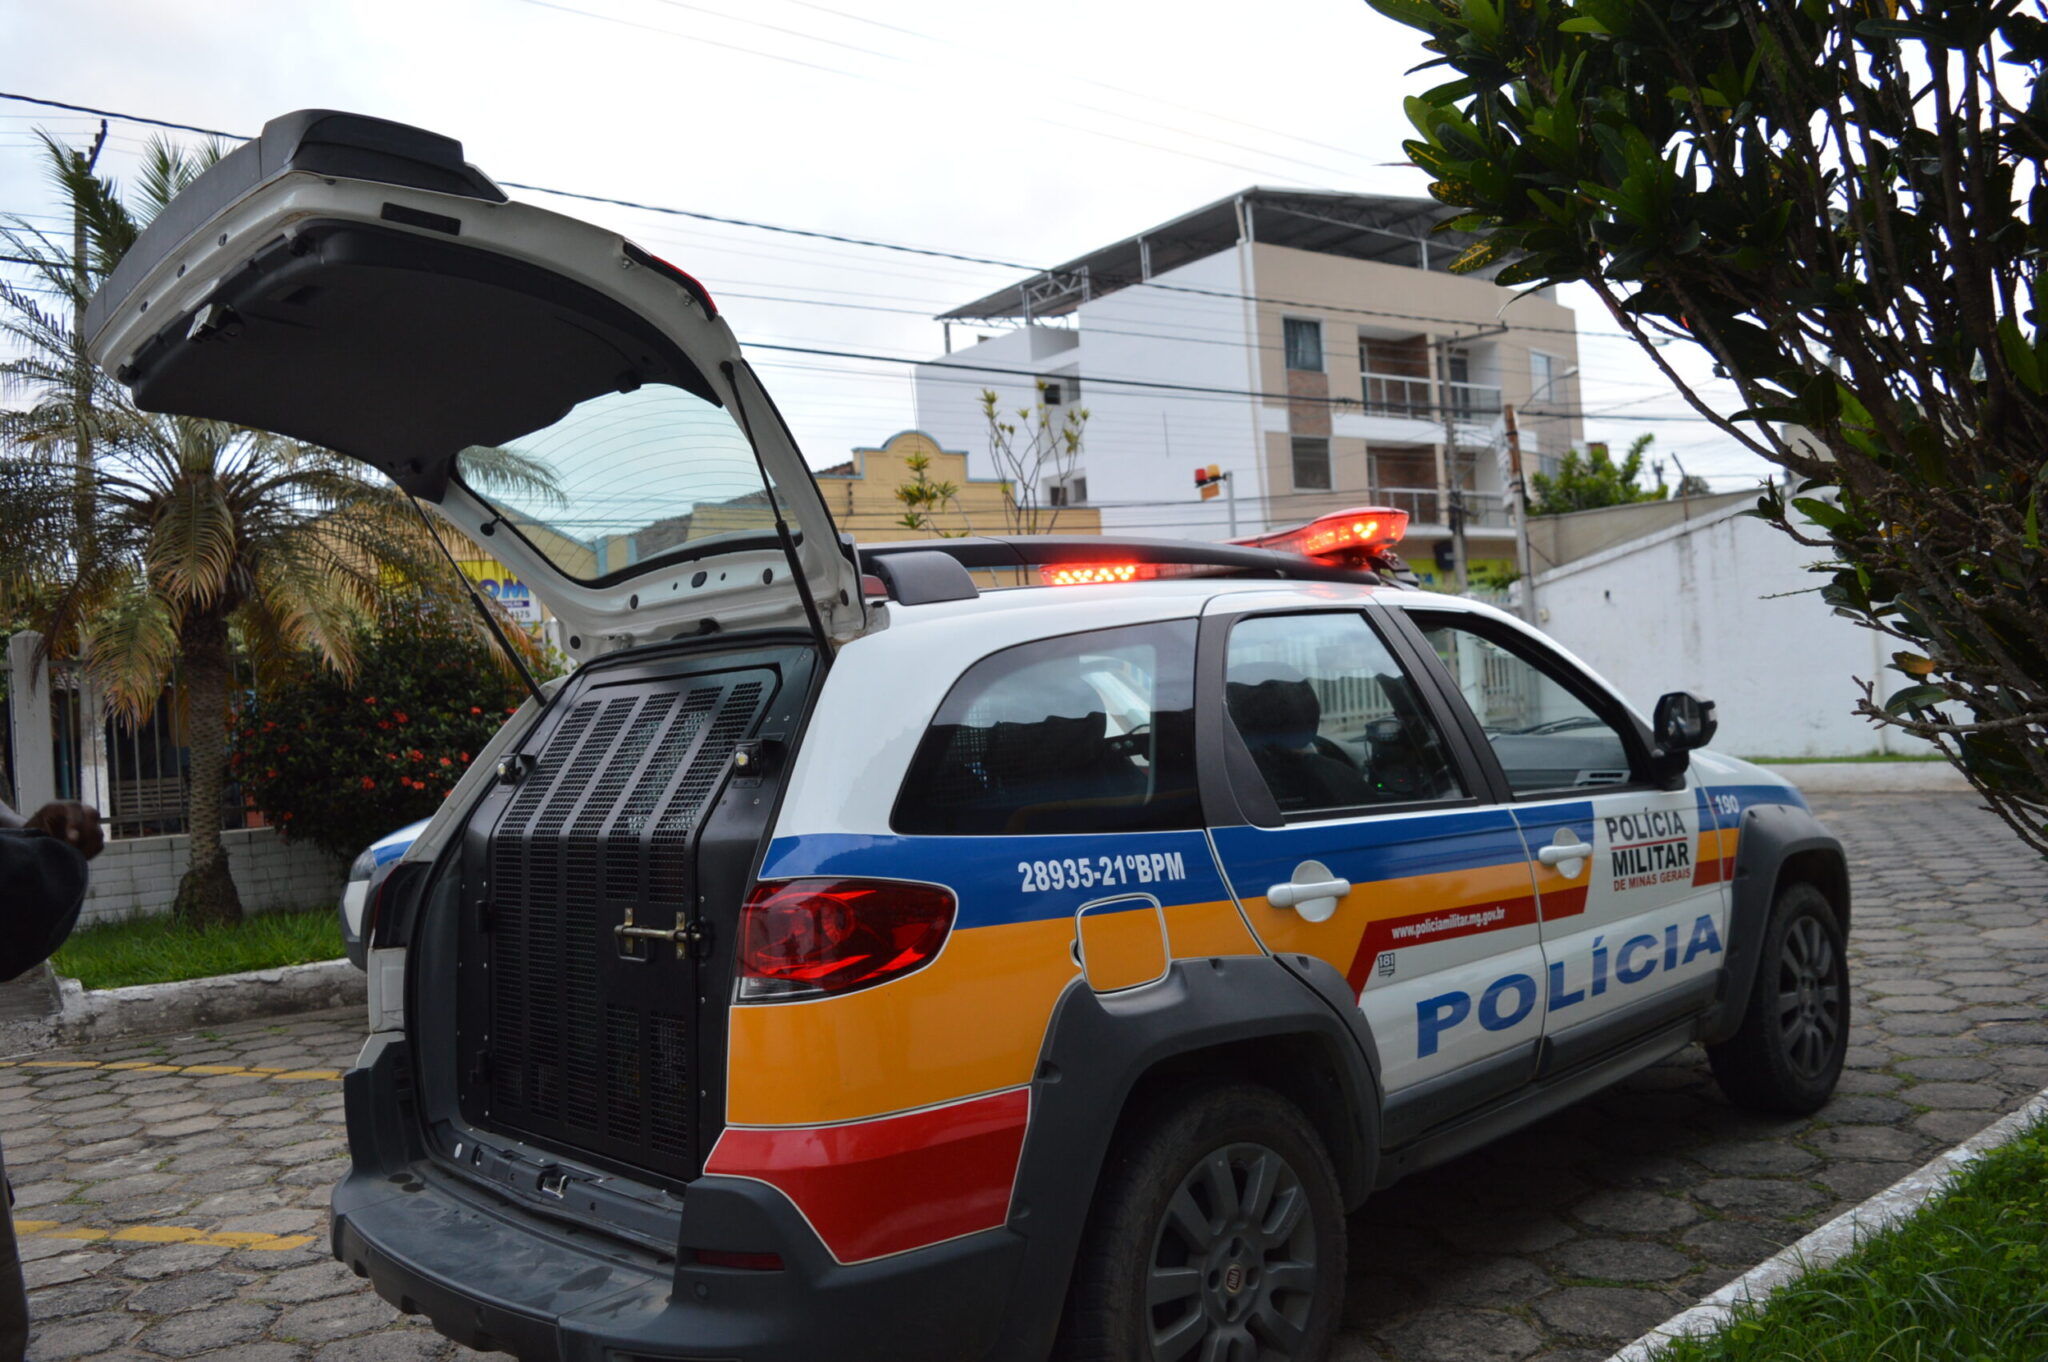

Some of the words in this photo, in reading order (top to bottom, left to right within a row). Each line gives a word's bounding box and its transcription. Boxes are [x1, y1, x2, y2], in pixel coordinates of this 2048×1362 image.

[1715, 795, 1740, 815] 190
[1604, 806, 1686, 843] POLÍCIA
[1611, 842, 1690, 877] MILITAR
[1614, 880, 1626, 892] DE
[1628, 874, 1657, 889] MINAS
[1660, 868, 1691, 883] GERAIS
[1391, 906, 1505, 939] www.policiamilitar.mg.gov.br
[1379, 954, 1395, 968] 181
[1416, 914, 1723, 1059] POLÍCIA
